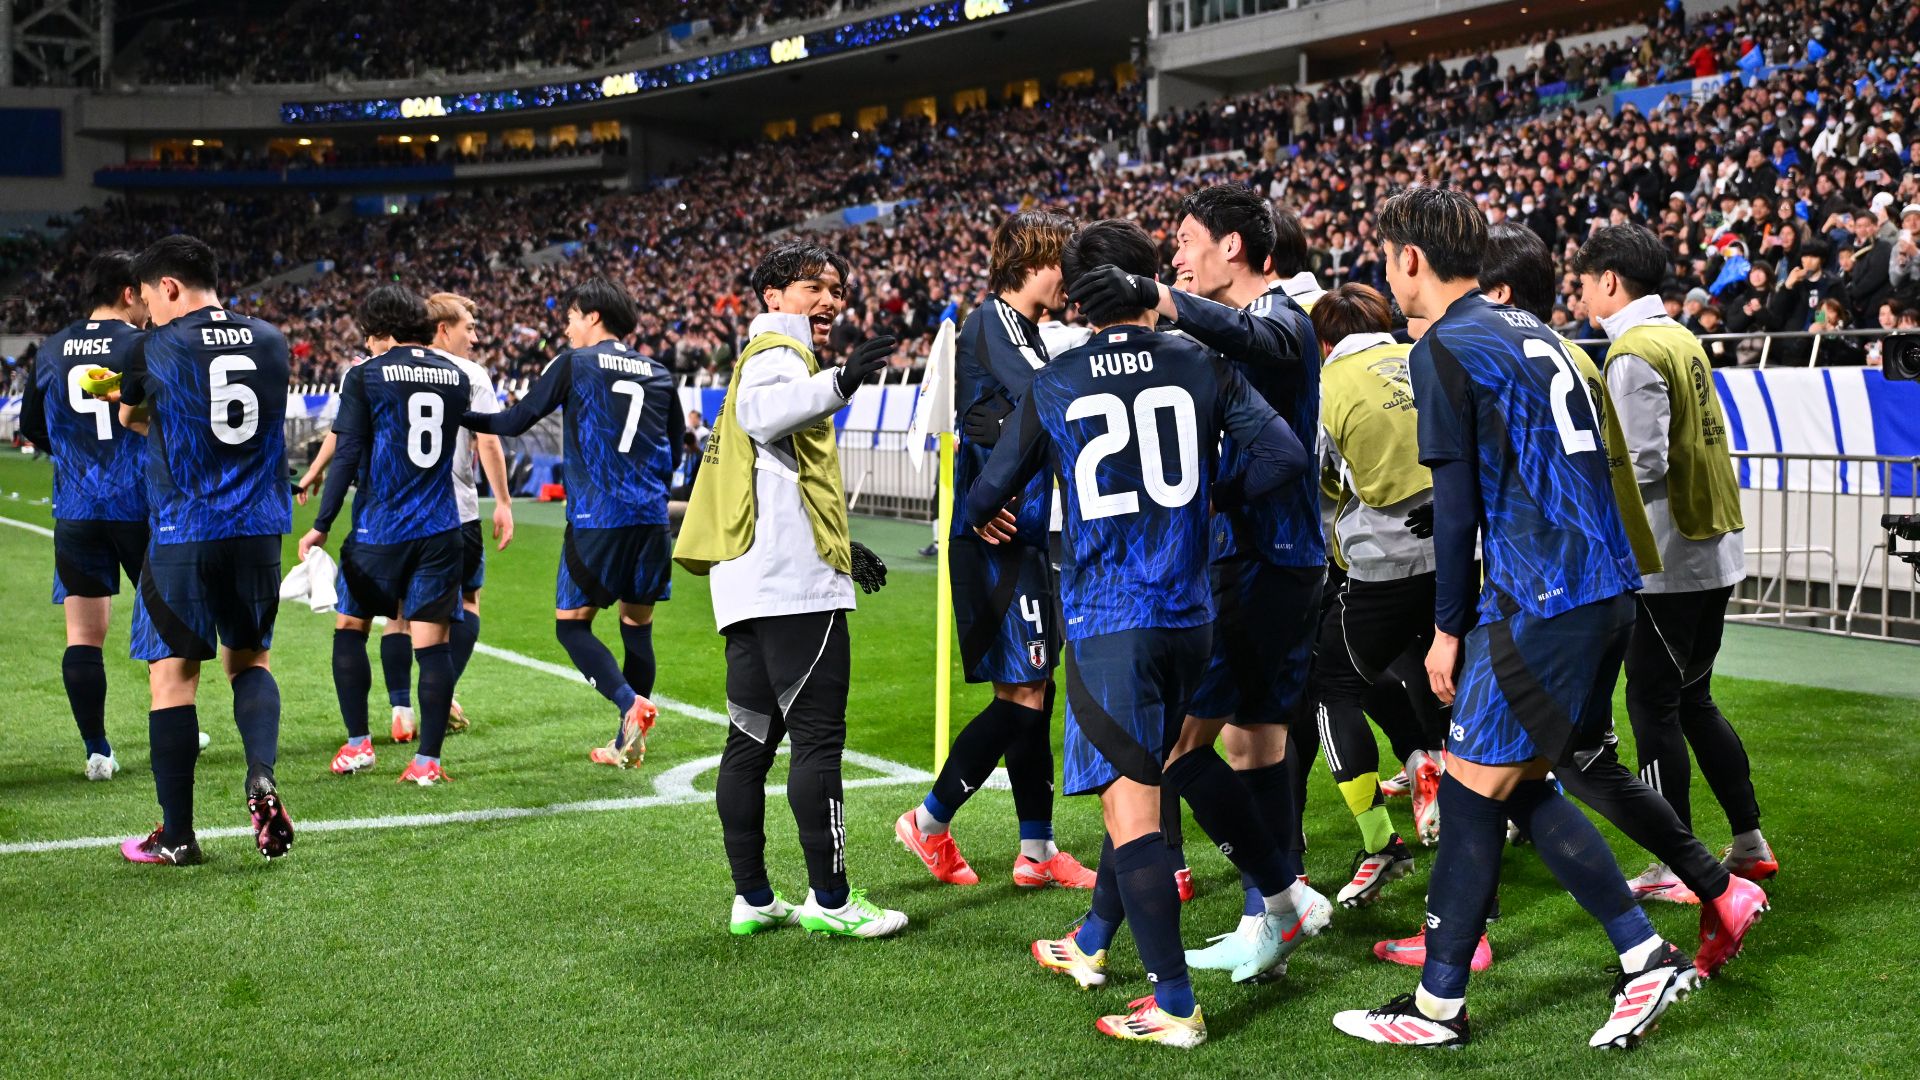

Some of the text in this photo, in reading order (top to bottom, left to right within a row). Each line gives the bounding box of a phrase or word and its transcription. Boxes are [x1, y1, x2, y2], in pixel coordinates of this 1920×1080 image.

[401, 96, 447, 118] GOAL
[63, 337, 113, 356] AYASE
[201, 327, 253, 345] ENDO
[382, 364, 460, 386] MINAMINO
[598, 353, 653, 377] MITOMA
[1089, 350, 1154, 378] KUBO
[67, 363, 113, 441] 9
[208, 354, 259, 445] 6
[611, 379, 645, 453] 7
[407, 391, 444, 468] 8
[1065, 385, 1200, 522] 20
[1020, 595, 1043, 633] 4
